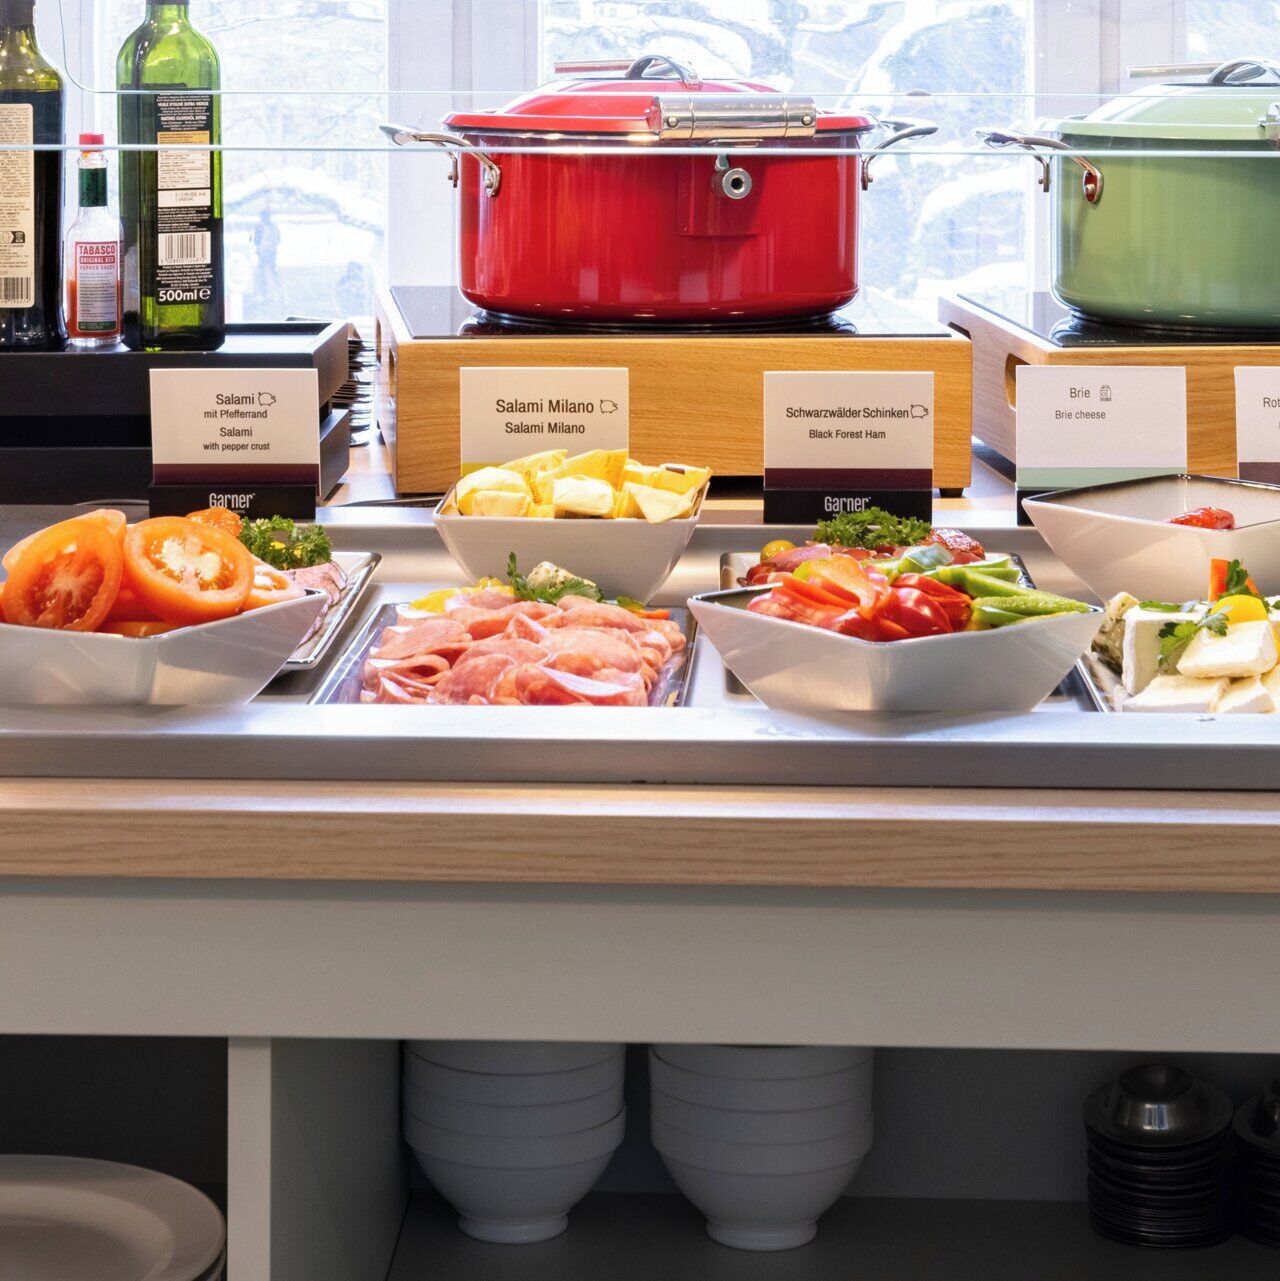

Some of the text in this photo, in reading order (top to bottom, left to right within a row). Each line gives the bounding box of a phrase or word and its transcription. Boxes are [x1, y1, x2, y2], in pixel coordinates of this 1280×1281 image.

[78, 244, 116, 256] TABASCO
[158, 289, 198, 302] 500ml
[1070, 387, 1090, 398] Brie
[216, 393, 255, 405] Salami
[496, 398, 594, 414] Salami Milano
[204, 409, 268, 419] mit Pfefferrand
[786, 407, 909, 419] Schwarzwälder Schinken
[1055, 410, 1106, 420] Brie cheese
[220, 426, 253, 437] Salami
[505, 421, 585, 434] Salami Milano
[809, 429, 886, 439] Black Forest Ham
[202, 442, 270, 452] with pepper crust
[209, 492, 253, 509] Garner
[823, 496, 869, 513] Garner
